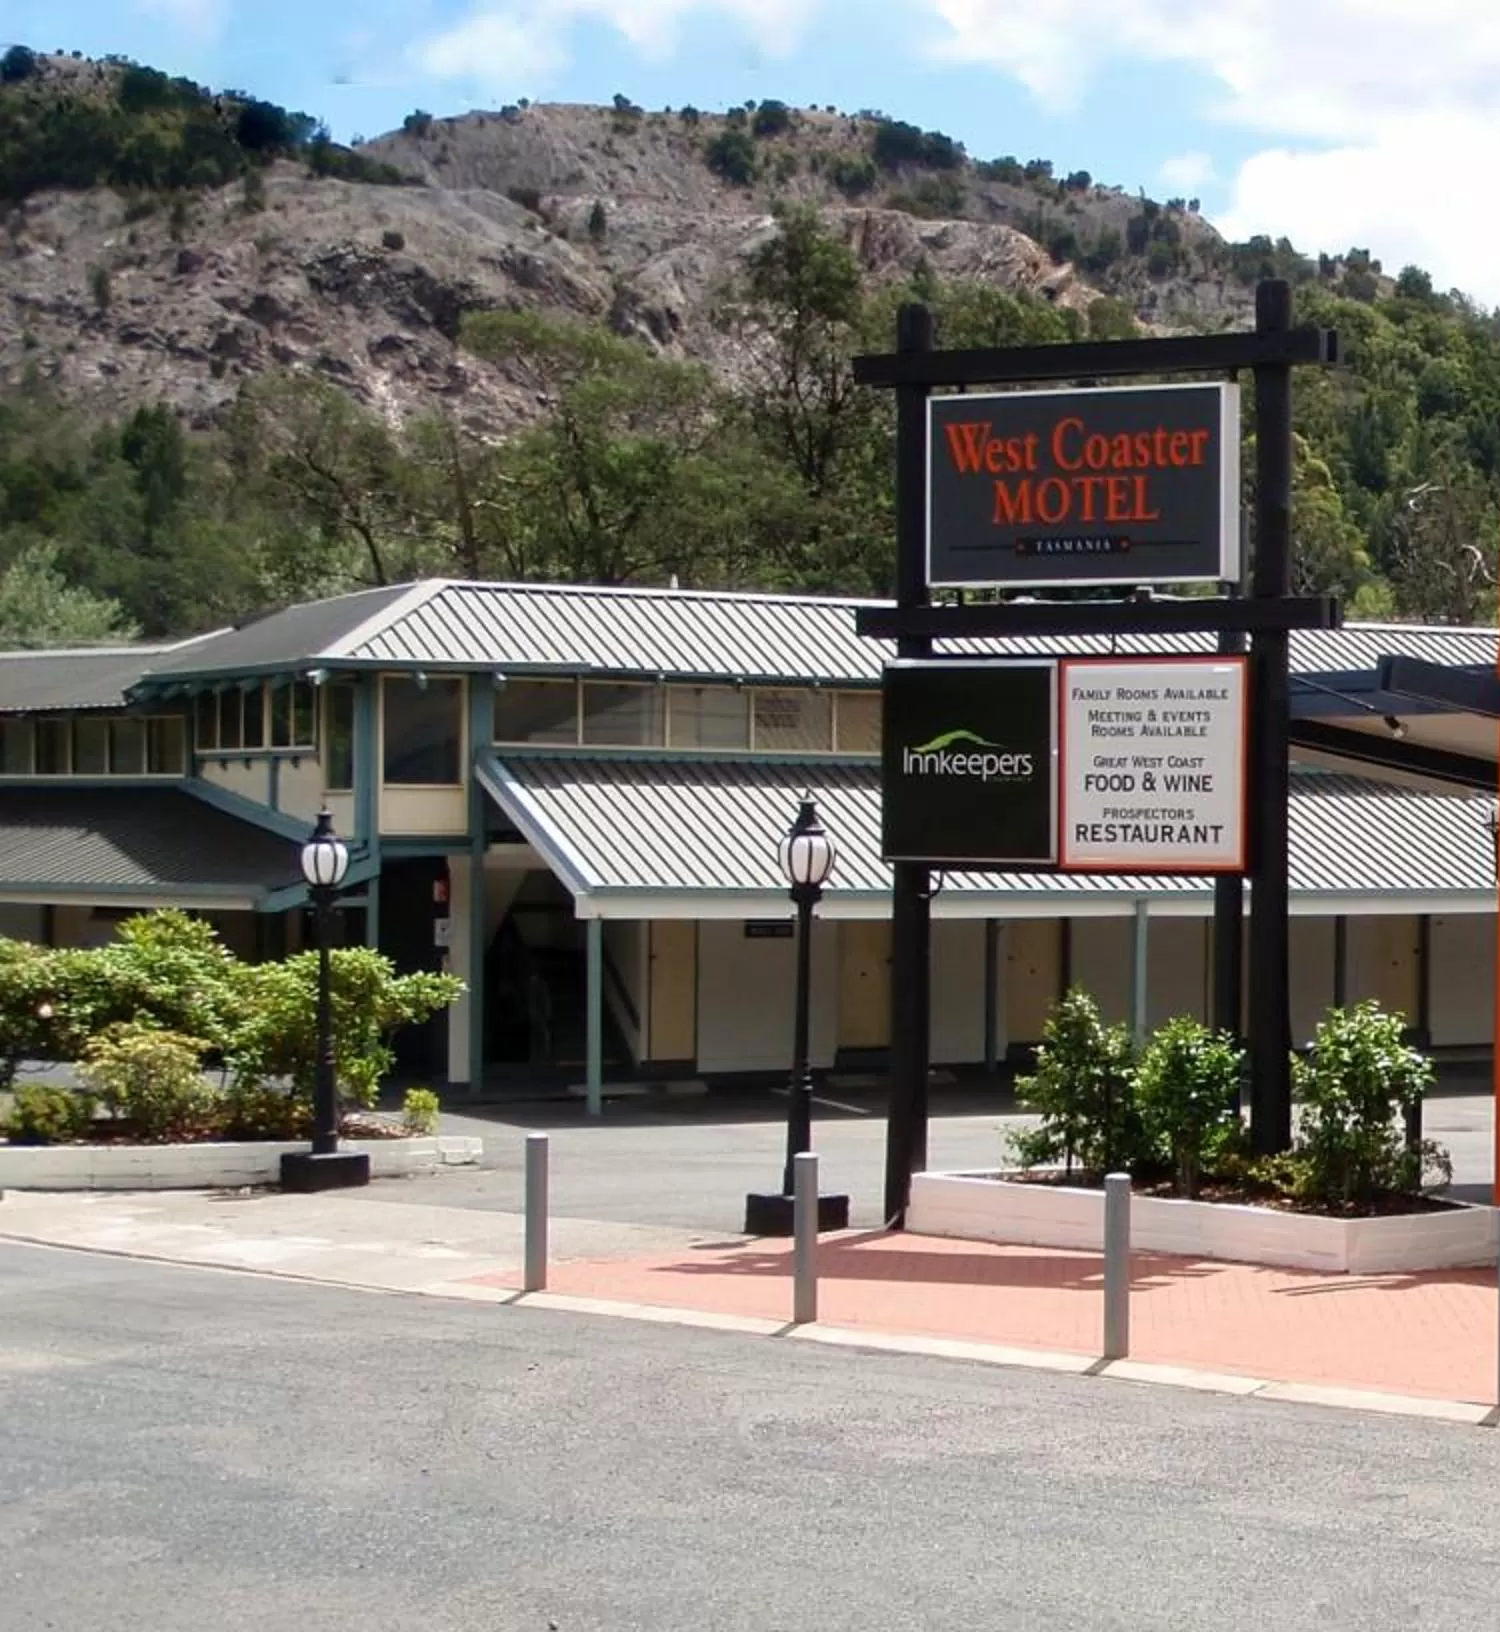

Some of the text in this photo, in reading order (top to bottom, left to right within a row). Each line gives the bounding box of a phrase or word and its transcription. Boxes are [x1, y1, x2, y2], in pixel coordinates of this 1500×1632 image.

[943, 416, 1209, 474] West Coaster
[992, 475, 1160, 525] MOTEL
[1036, 538, 1111, 552] TASMANIA
[1148, 709, 1157, 722] &
[1162, 711, 1211, 722] EVENTS
[903, 746, 1033, 782] Innkeepers
[1084, 772, 1213, 793] FOOD & WINE
[1102, 808, 1195, 821] PROSPECTORS
[1075, 824, 1223, 844] RESTAURANT
